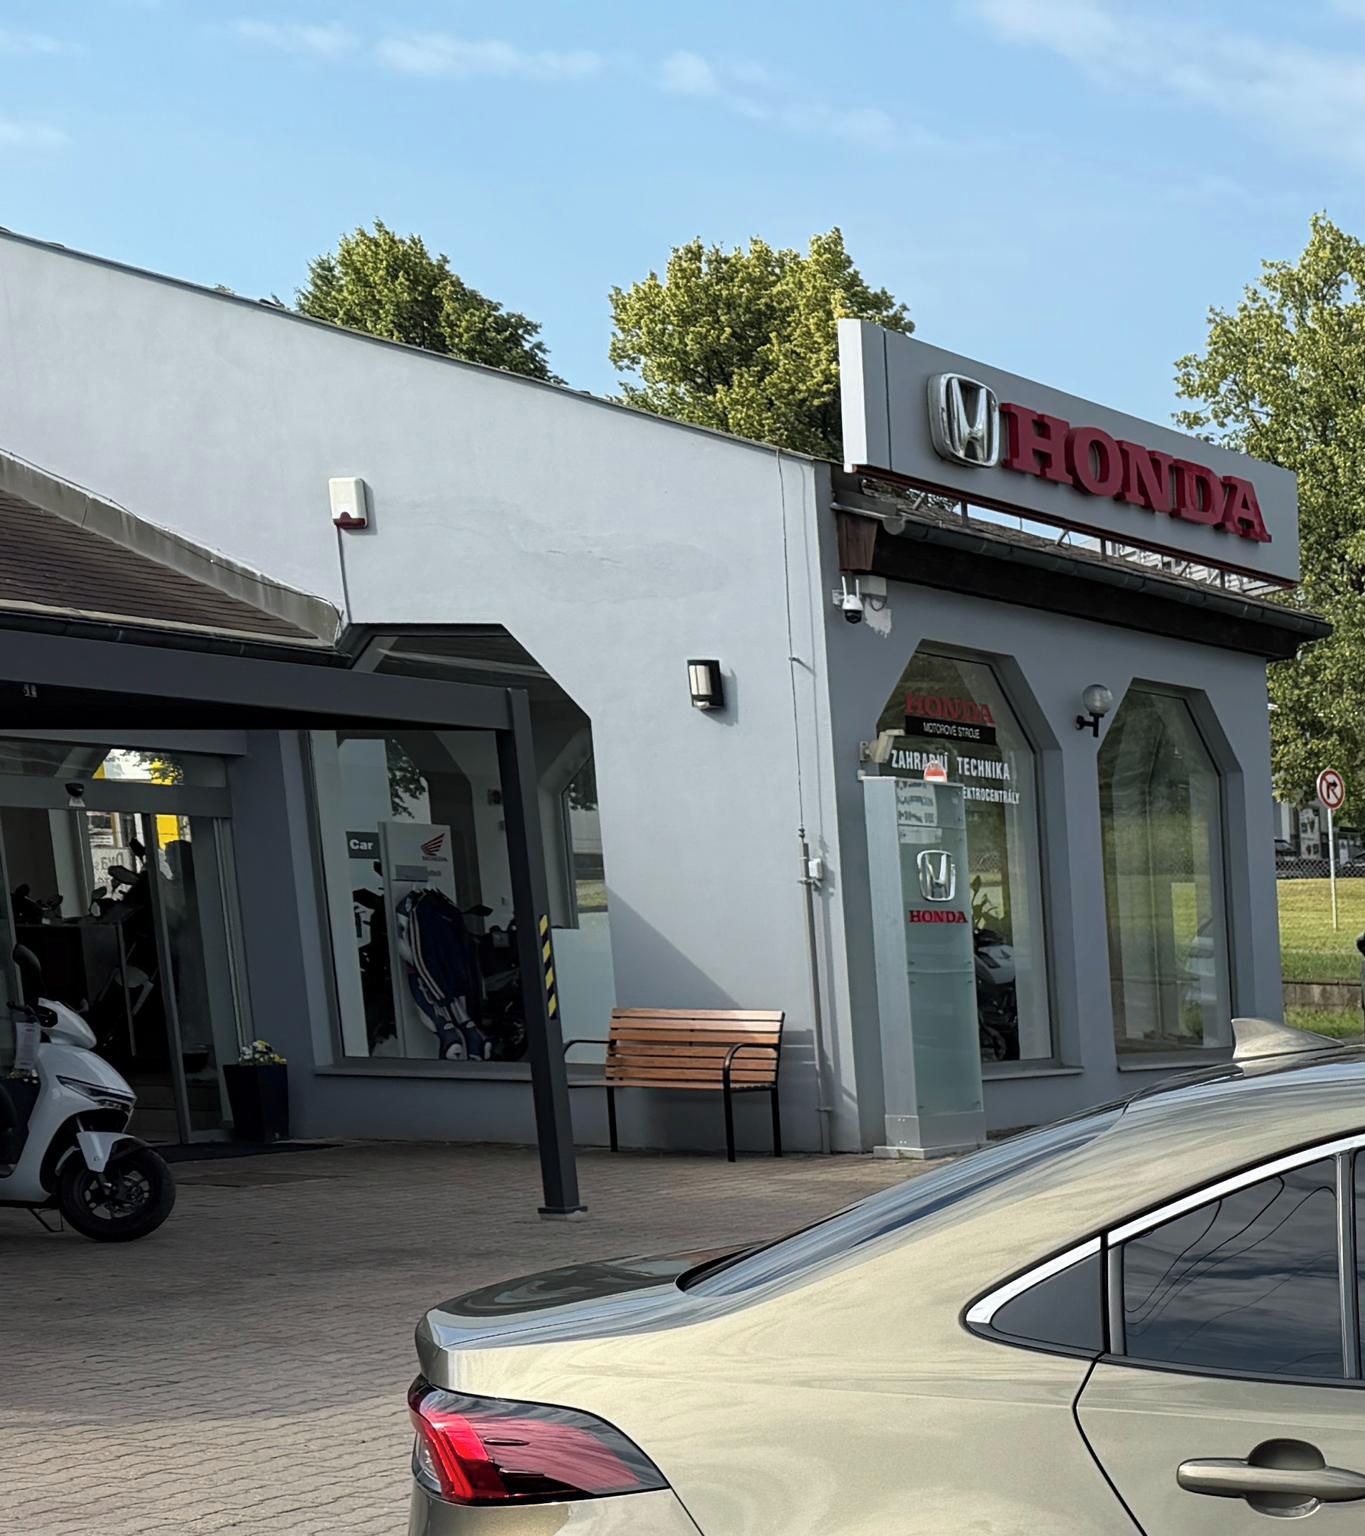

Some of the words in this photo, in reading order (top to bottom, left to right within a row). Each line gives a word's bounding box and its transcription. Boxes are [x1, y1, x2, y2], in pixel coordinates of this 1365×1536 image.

[1000, 402, 1272, 543] HONDA
[905, 693, 995, 725] HONDA
[956, 756, 1011, 781] TECHNIKA
[963, 786, 1020, 804] EKTROCENTRÁLY
[349, 839, 374, 850] Car
[909, 910, 968, 924] HONDA
